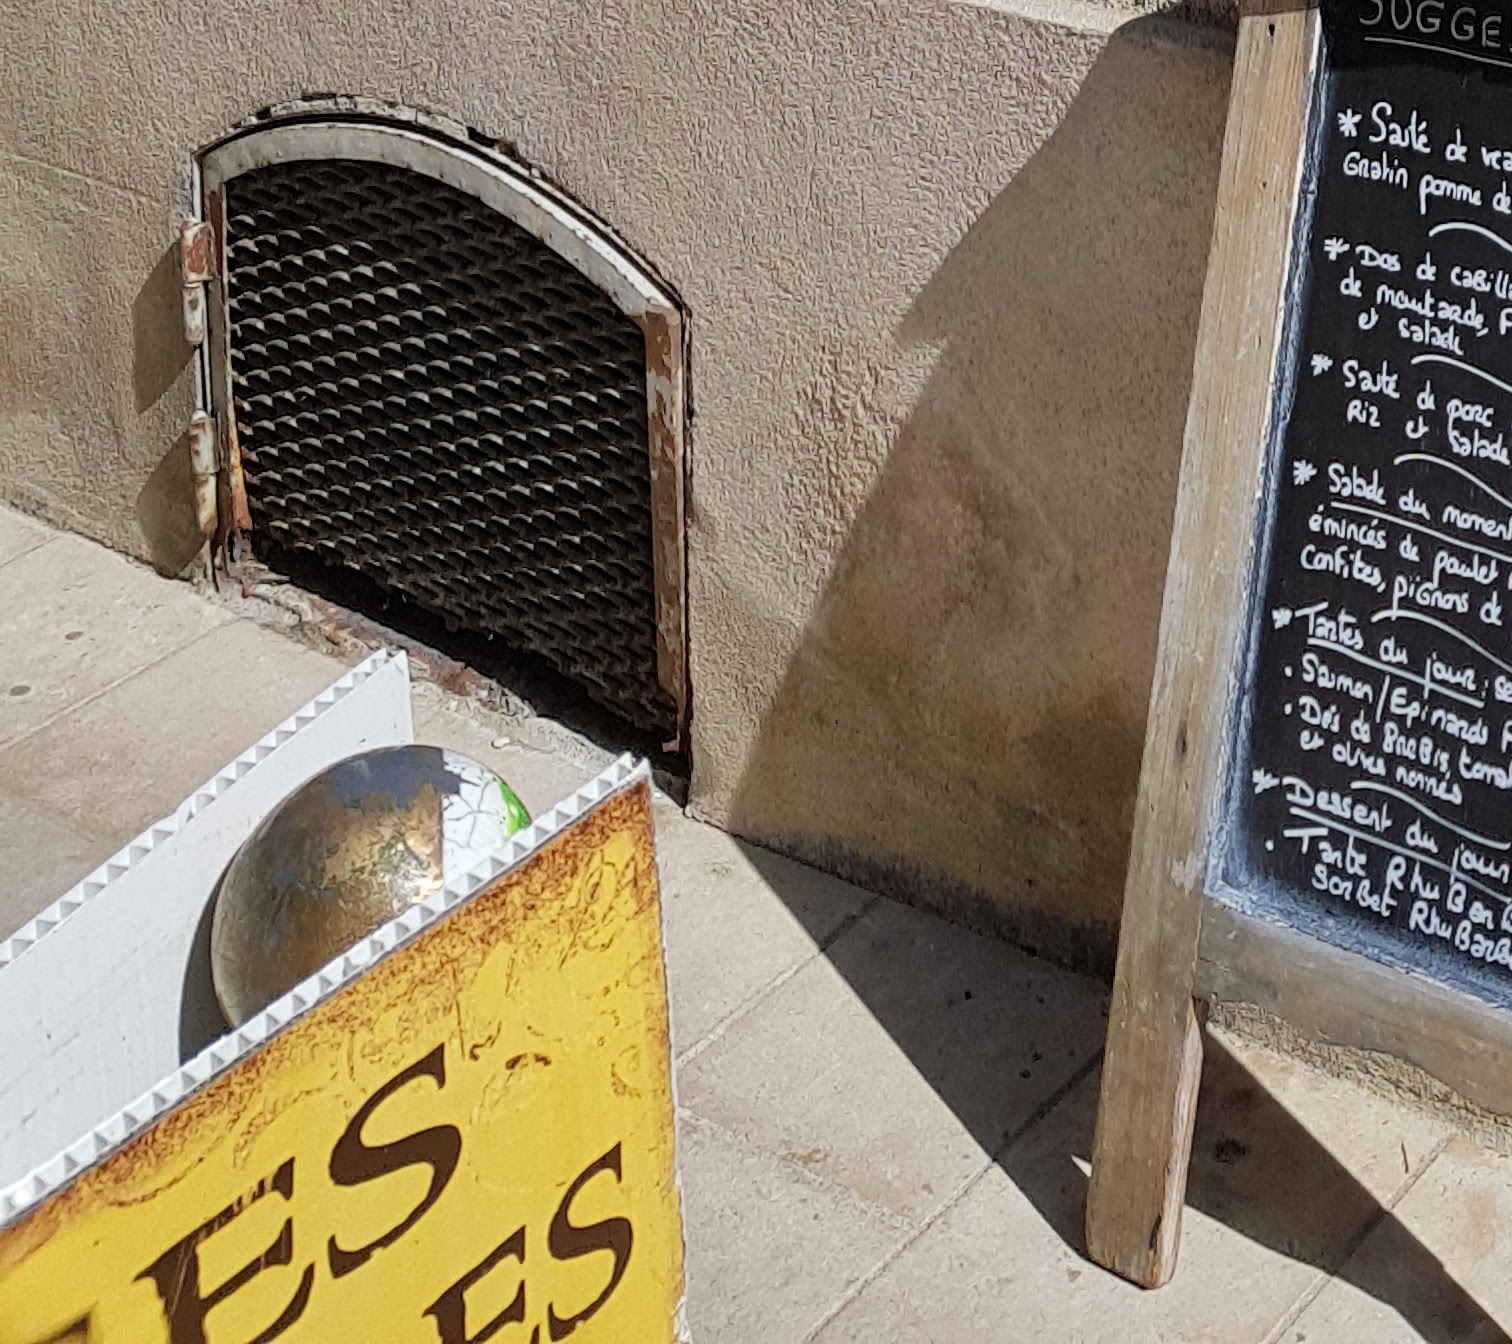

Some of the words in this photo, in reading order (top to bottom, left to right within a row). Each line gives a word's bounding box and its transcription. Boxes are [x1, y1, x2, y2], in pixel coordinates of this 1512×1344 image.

[1369, 102, 1431, 153] Sauté
[1445, 128, 1467, 162] de
[1343, 151, 1408, 189] Gratin
[1419, 173, 1481, 215] pomme
[1492, 177, 1511, 215] de
[1356, 244, 1401, 271] Dos
[1416, 251, 1437, 281] de
[1340, 266, 1362, 297] de
[1377, 284, 1489, 337] moutarde,
[1358, 307, 1379, 330] et
[1343, 359, 1400, 399] Sauté
[1416, 378, 1435, 410] de
[1447, 397, 1495, 436] porc
[1346, 399, 1381, 428] Riz
[1404, 413, 1429, 439] et
[1327, 462, 1387, 506] Salade
[1398, 488, 1431, 520] du
[1308, 502, 1388, 550] émincés
[1399, 533, 1420, 563] de
[1432, 550, 1499, 591] poulet
[1295, 601, 1364, 650] Tartes
[1379, 635, 1409, 665] du
[1479, 591, 1502, 626] de
[1299, 695, 1340, 733] Dés
[1350, 708, 1372, 744] de
[1299, 730, 1324, 751] et
[1332, 741, 1387, 776] olives
[1395, 761, 1463, 806] noires
[1282, 776, 1393, 833] Dessert
[1405, 816, 1439, 854] du
[1282, 825, 1368, 878] Tarte
[30, 1042, 463, 1344] ES
